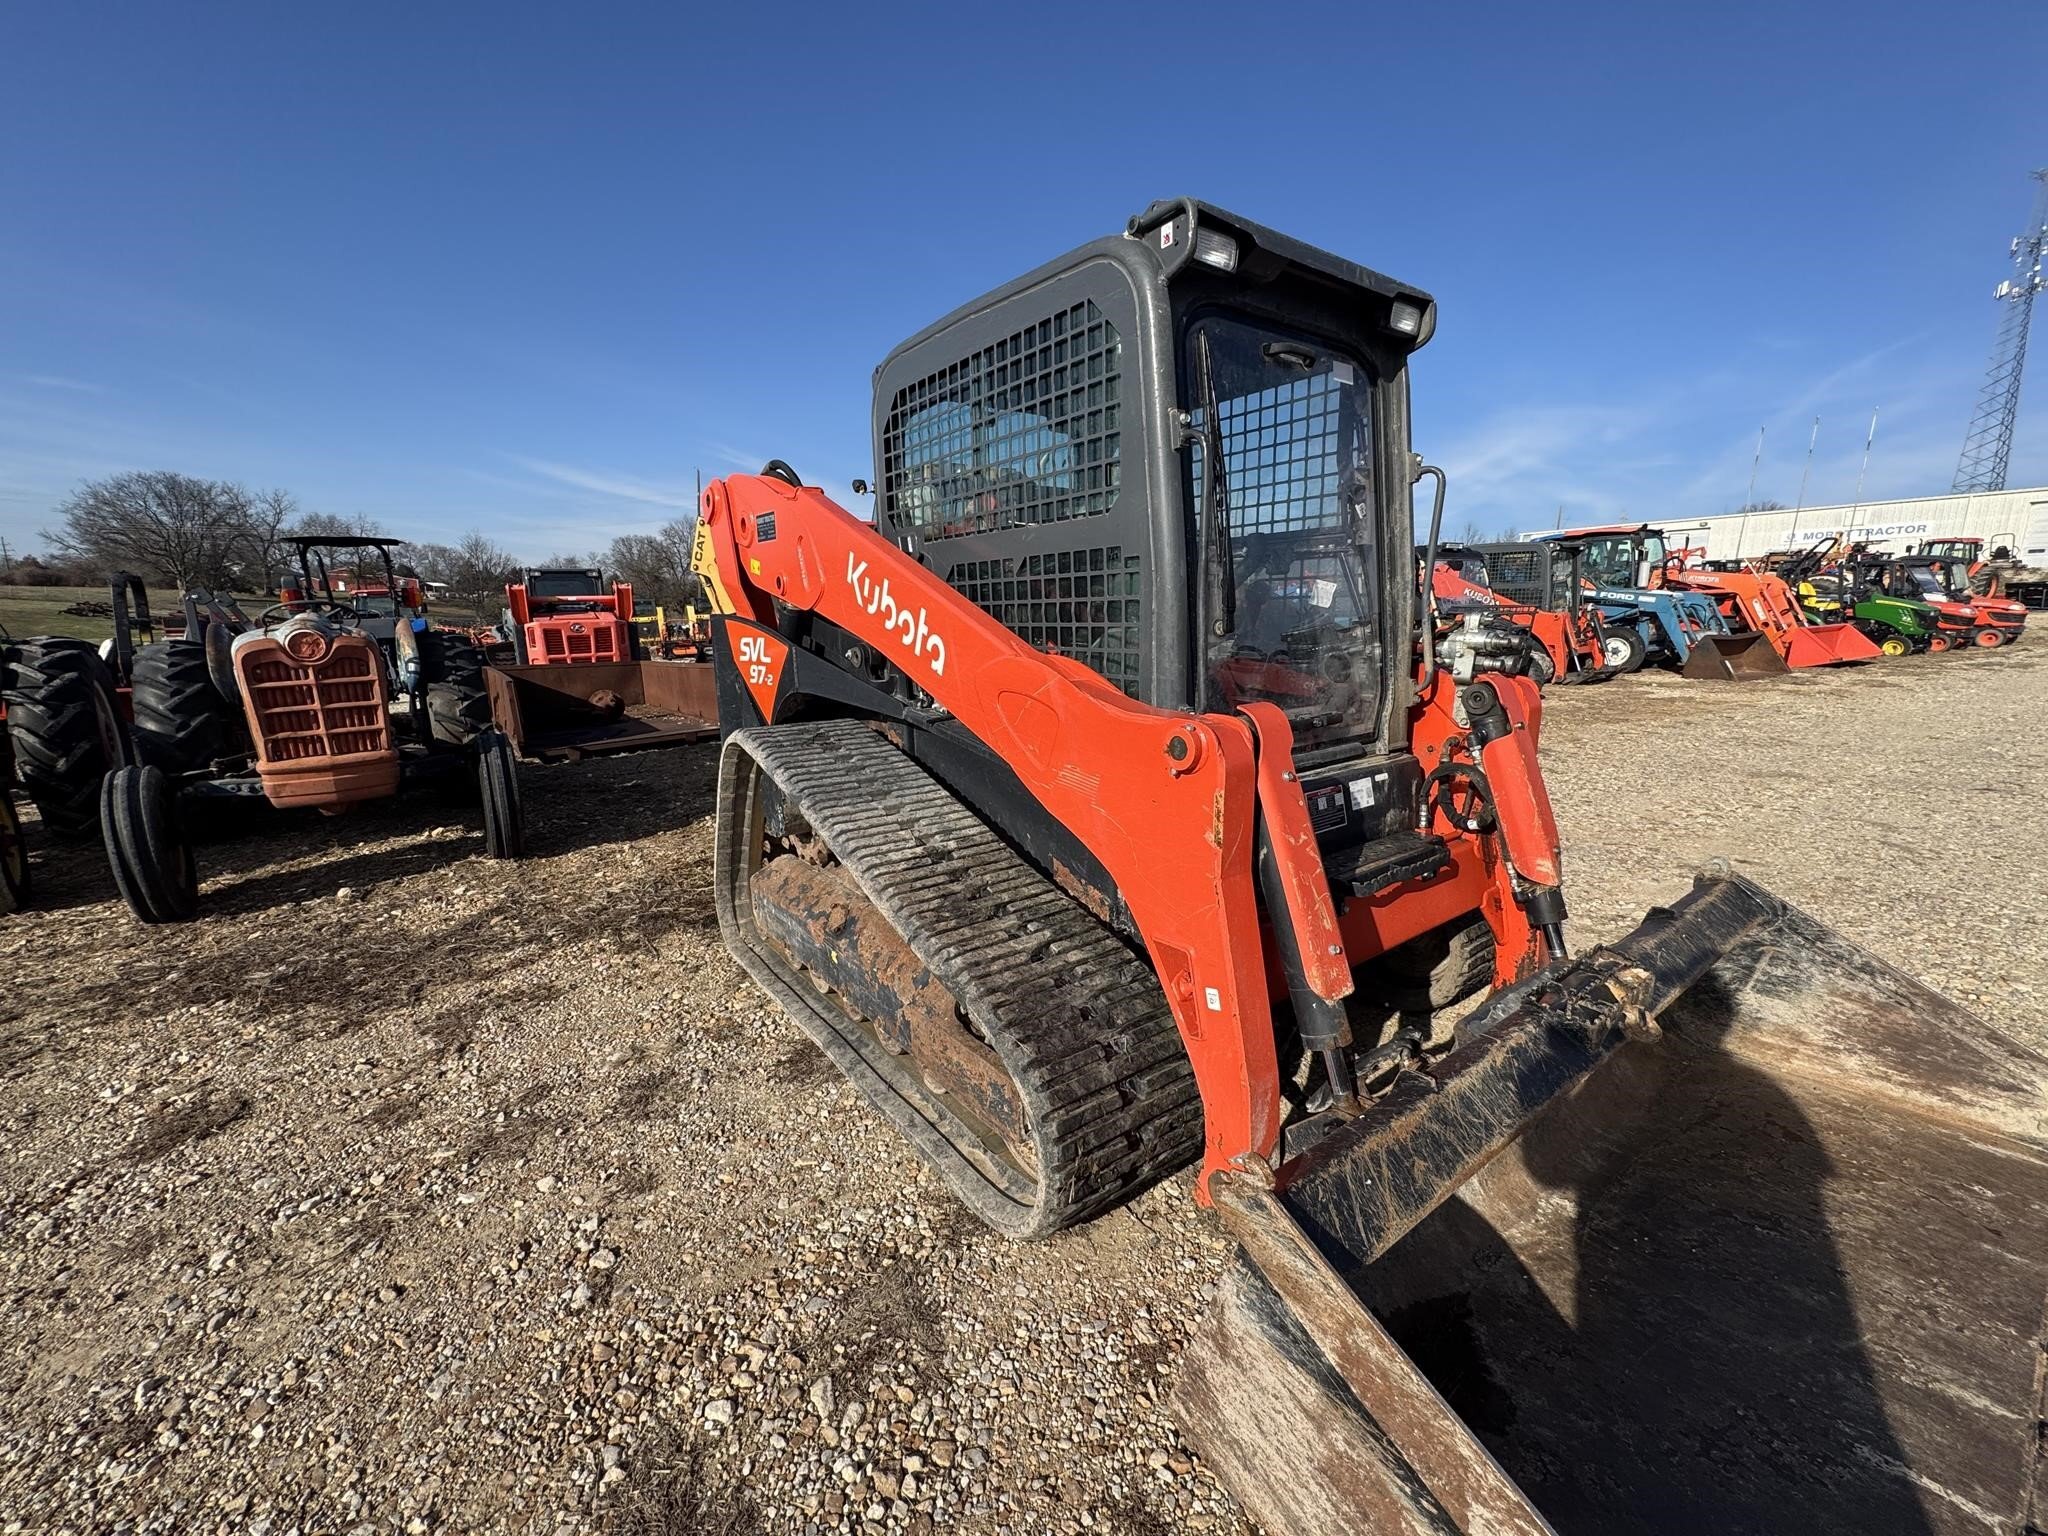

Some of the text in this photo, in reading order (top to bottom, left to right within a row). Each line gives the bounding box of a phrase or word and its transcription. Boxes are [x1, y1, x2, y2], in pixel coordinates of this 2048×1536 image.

[1856, 524, 1927, 537] TRACTOR
[695, 531, 706, 562] CAT
[1600, 591, 1635, 601] FORD
[847, 551, 945, 676] Kubota
[739, 637, 771, 663] SVL
